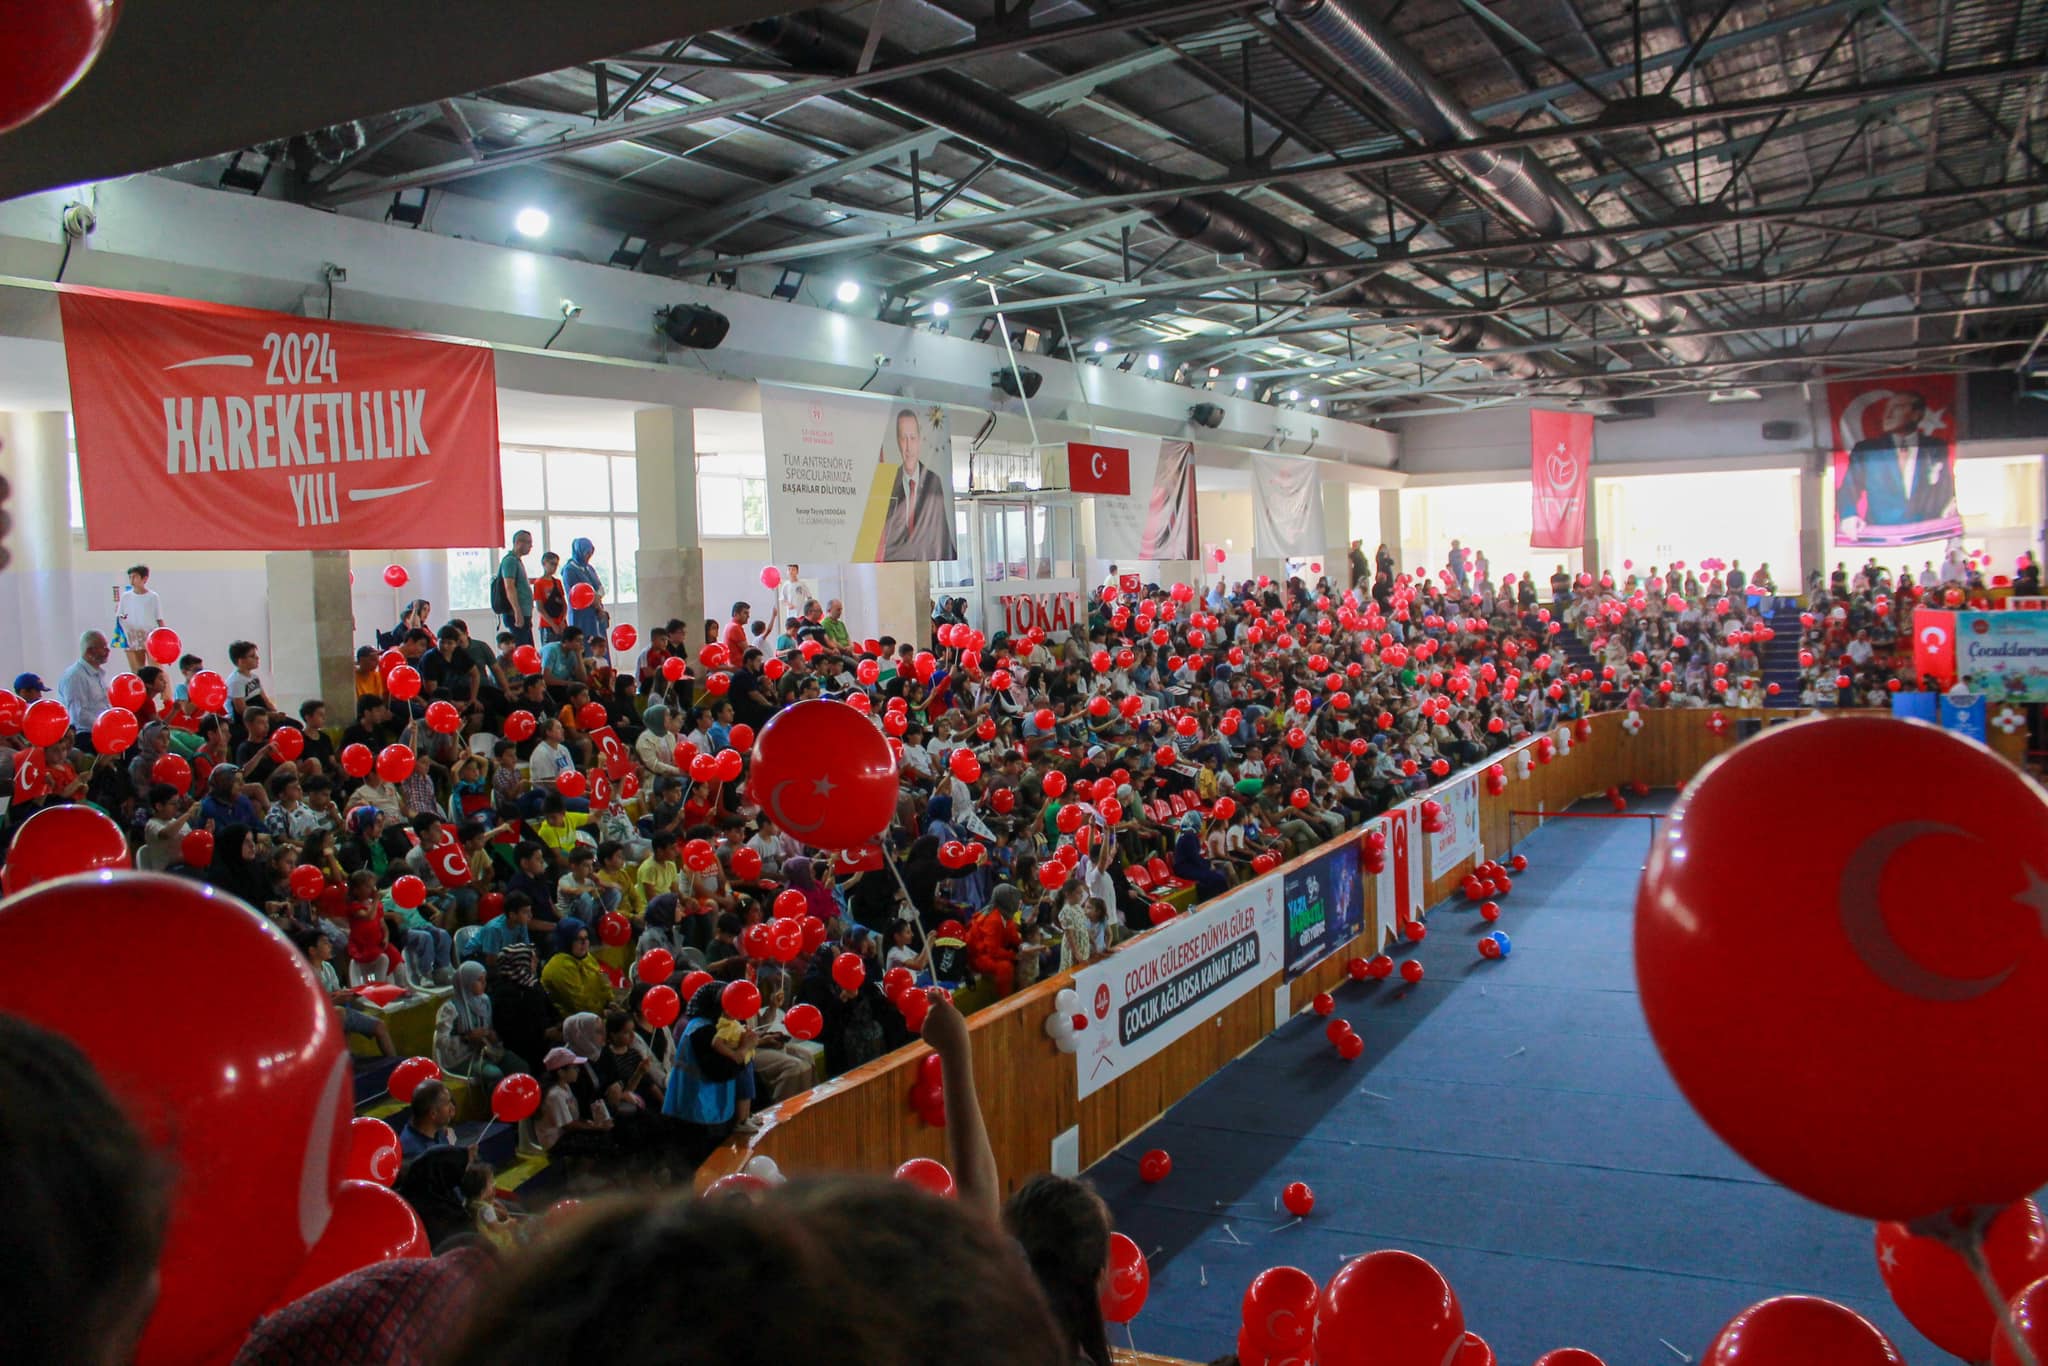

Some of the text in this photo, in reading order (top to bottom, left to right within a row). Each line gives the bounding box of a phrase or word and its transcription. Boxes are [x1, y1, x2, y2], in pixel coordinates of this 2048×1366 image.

[263, 332, 338, 385] 2024
[163, 389, 430, 474] HAREKETLİLİK
[288, 472, 339, 527] YILI
[782, 483, 820, 495] BAŞARILAR
[1542, 497, 1579, 521] TVF
[999, 592, 1080, 636] TOKAT
[1125, 958, 1159, 1003] ÇOCUK
[1160, 936, 1199, 977] GÜLERSE
[1201, 920, 1229, 956] DÜNYA
[1230, 907, 1255, 937] GÜLER
[1125, 996, 1160, 1040] ÇOCUK
[1160, 972, 1200, 1016] AĞLARSA
[1201, 955, 1230, 991] KAİNAT
[1231, 939, 1256, 972] AĞLAR
